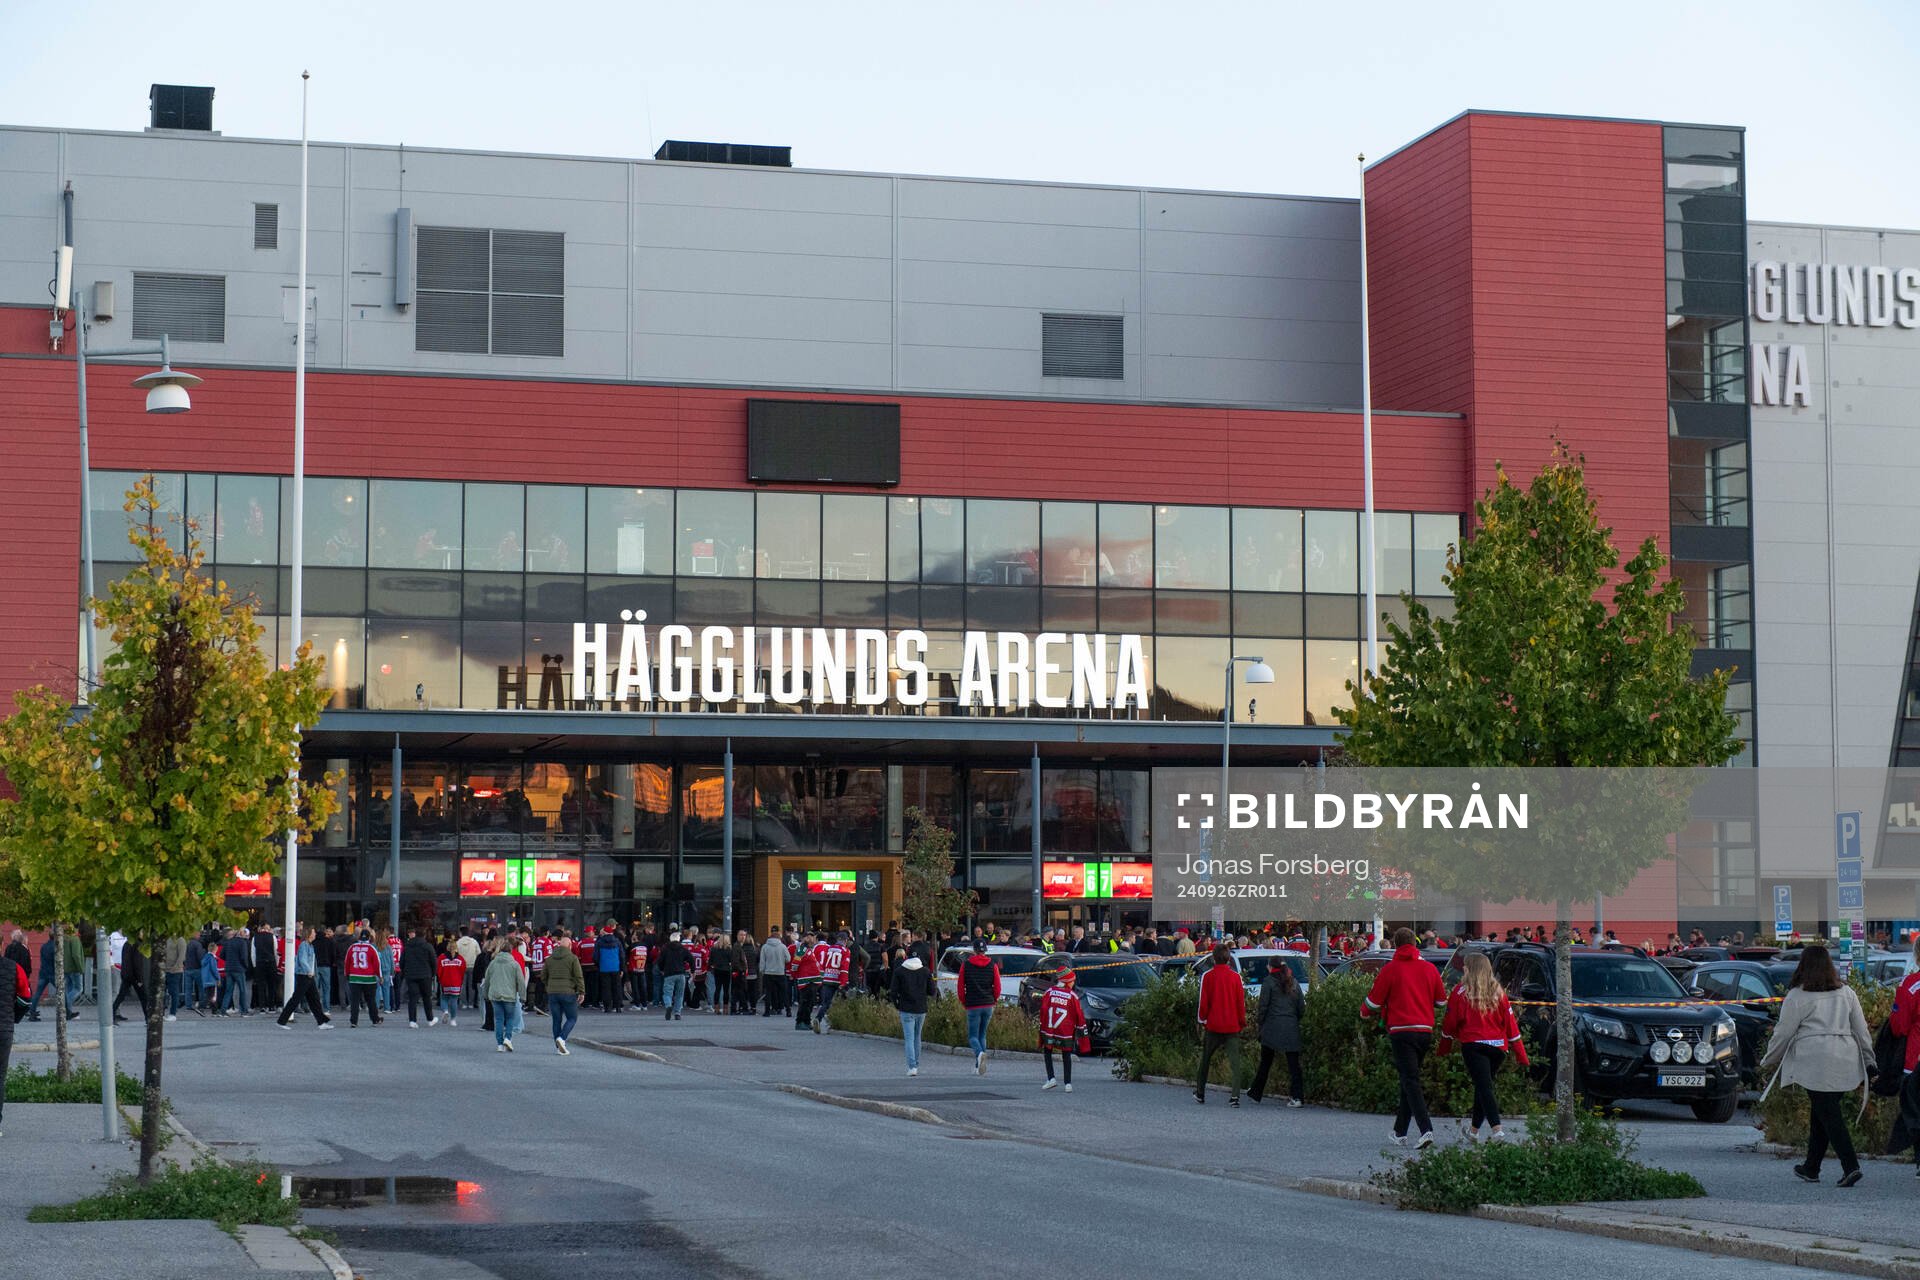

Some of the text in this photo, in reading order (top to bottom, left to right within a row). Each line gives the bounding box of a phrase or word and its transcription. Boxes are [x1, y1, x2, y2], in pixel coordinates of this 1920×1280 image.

[1748, 261, 1920, 329] GLUNDS
[1751, 344, 1812, 407] NA
[573, 608, 1149, 710] HÄGGLUNDS ARENA
[1842, 816, 1856, 854] P
[471, 872, 496, 882] PUBLIK
[508, 872, 518, 889] 3
[523, 872, 533, 889] 4
[546, 872, 571, 882] PUBLIK
[1086, 876, 1096, 892] 6
[1100, 876, 1109, 892] 7
[1778, 888, 1788, 902] P
[352, 952, 369, 969] 19
[825, 951, 842, 969] 70
[1050, 996, 1068, 1006] WOODS
[1047, 1006, 1068, 1029] 17
[1665, 1076, 1702, 1085] YSC 92Z
